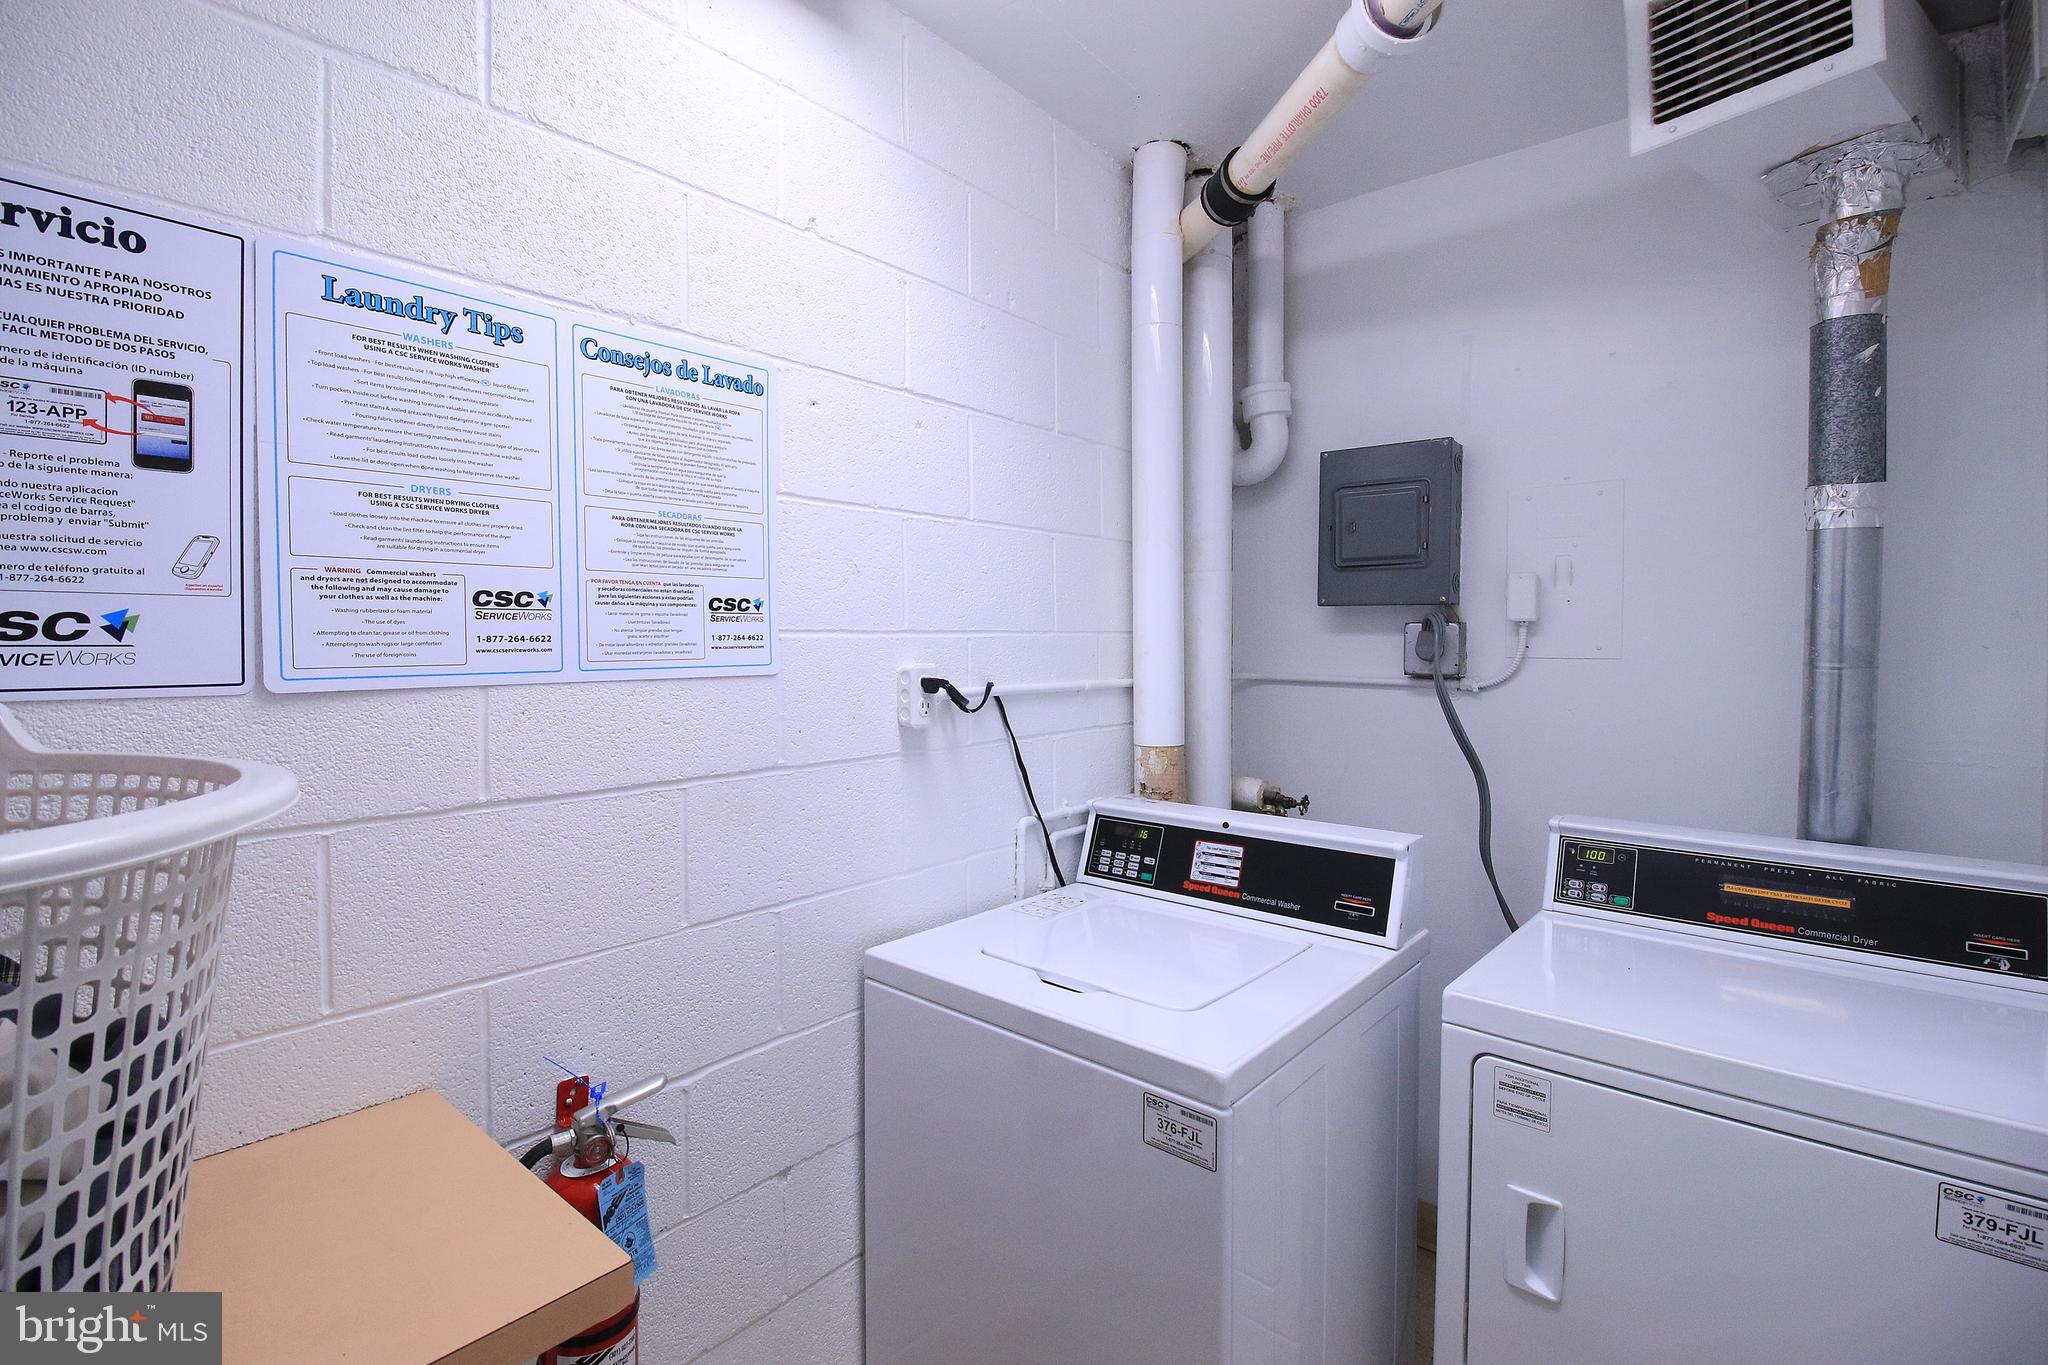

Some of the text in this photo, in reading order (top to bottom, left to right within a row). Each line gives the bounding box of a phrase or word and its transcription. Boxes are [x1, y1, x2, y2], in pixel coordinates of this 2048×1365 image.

[8, 250, 211, 299] IMPORTANTE PARA NOSOTROS
[83, 279, 162, 302] APROPIADO
[25, 281, 184, 319] ES NUESTRA PRIORIDAD
[320, 274, 524, 346] Laundry Tips
[1, 323, 175, 359] FACIL METODO DE DOS PASOS
[67, 322, 131, 341] PROBLEMA
[133, 334, 155, 345] DEL
[156, 338, 208, 355] SERVICIO,
[402, 332, 454, 350] WASHERS
[351, 333, 499, 368] FOR BEST RESULTS WHEN WASHING CLOTHES
[17, 357, 28, 367] la
[31, 361, 83, 375] máquina
[33, 349, 48, 358] de
[51, 351, 128, 370] identificación
[131, 364, 146, 373] (ID
[149, 368, 194, 381] number)
[580, 338, 765, 397] Consejos de Lavado
[655, 386, 701, 401] LAVADORAS
[6, 400, 88, 420] 123-APP
[9, 449, 120, 467] Reporte el problema
[7, 460, 133, 479] de la siguiente manera:
[21, 482, 118, 496] nuestra aplicacion
[410, 484, 452, 496] DRYERS
[10, 501, 115, 517] el codigo de barras,
[48, 493, 87, 504] Service
[89, 496, 135, 508] Request"
[357, 490, 373, 498] FOR
[374, 492, 392, 500] BEST
[393, 494, 422, 502] RESULTS
[445, 499, 470, 507] DRYING
[471, 501, 499, 510] CLOTHES
[0, 512, 149, 529] problema y enviar "Submit"
[657, 511, 702, 521] SECADORAS
[39, 534, 142, 547] solicitud de servicio
[19, 545, 107, 555] www.cscsw.com
[27, 562, 41, 571] de
[44, 564, 89, 573] teléfono
[91, 567, 134, 575] gratuito
[136, 567, 145, 575] al
[324, 566, 361, 574] WARNING
[365, 568, 408, 576] Commercial
[0, 573, 84, 583] 1-877-264-6622
[316, 575, 341, 583] dryers
[368, 577, 401, 585] designed
[324, 584, 360, 592] following
[413, 587, 441, 595] damage
[472, 589, 534, 608] CSC
[708, 597, 752, 612] CSC
[476, 635, 552, 643] 1-877-264-6622
[1140, 830, 1148, 839] 16
[1585, 850, 1606, 861] 100
[1695, 858, 1898, 888] PERMANENT PRESS ALL FABRIC
[1183, 880, 1301, 911] Speed Queen Commercial Washer
[1706, 912, 1879, 947] Speed Queen Commercial Dryer
[1146, 1096, 1164, 1108] CSC
[1157, 1118, 1203, 1146] 376-FJL
[1943, 1188, 1975, 1201] CSC
[1962, 1212, 2044, 1246] 379-FJL
